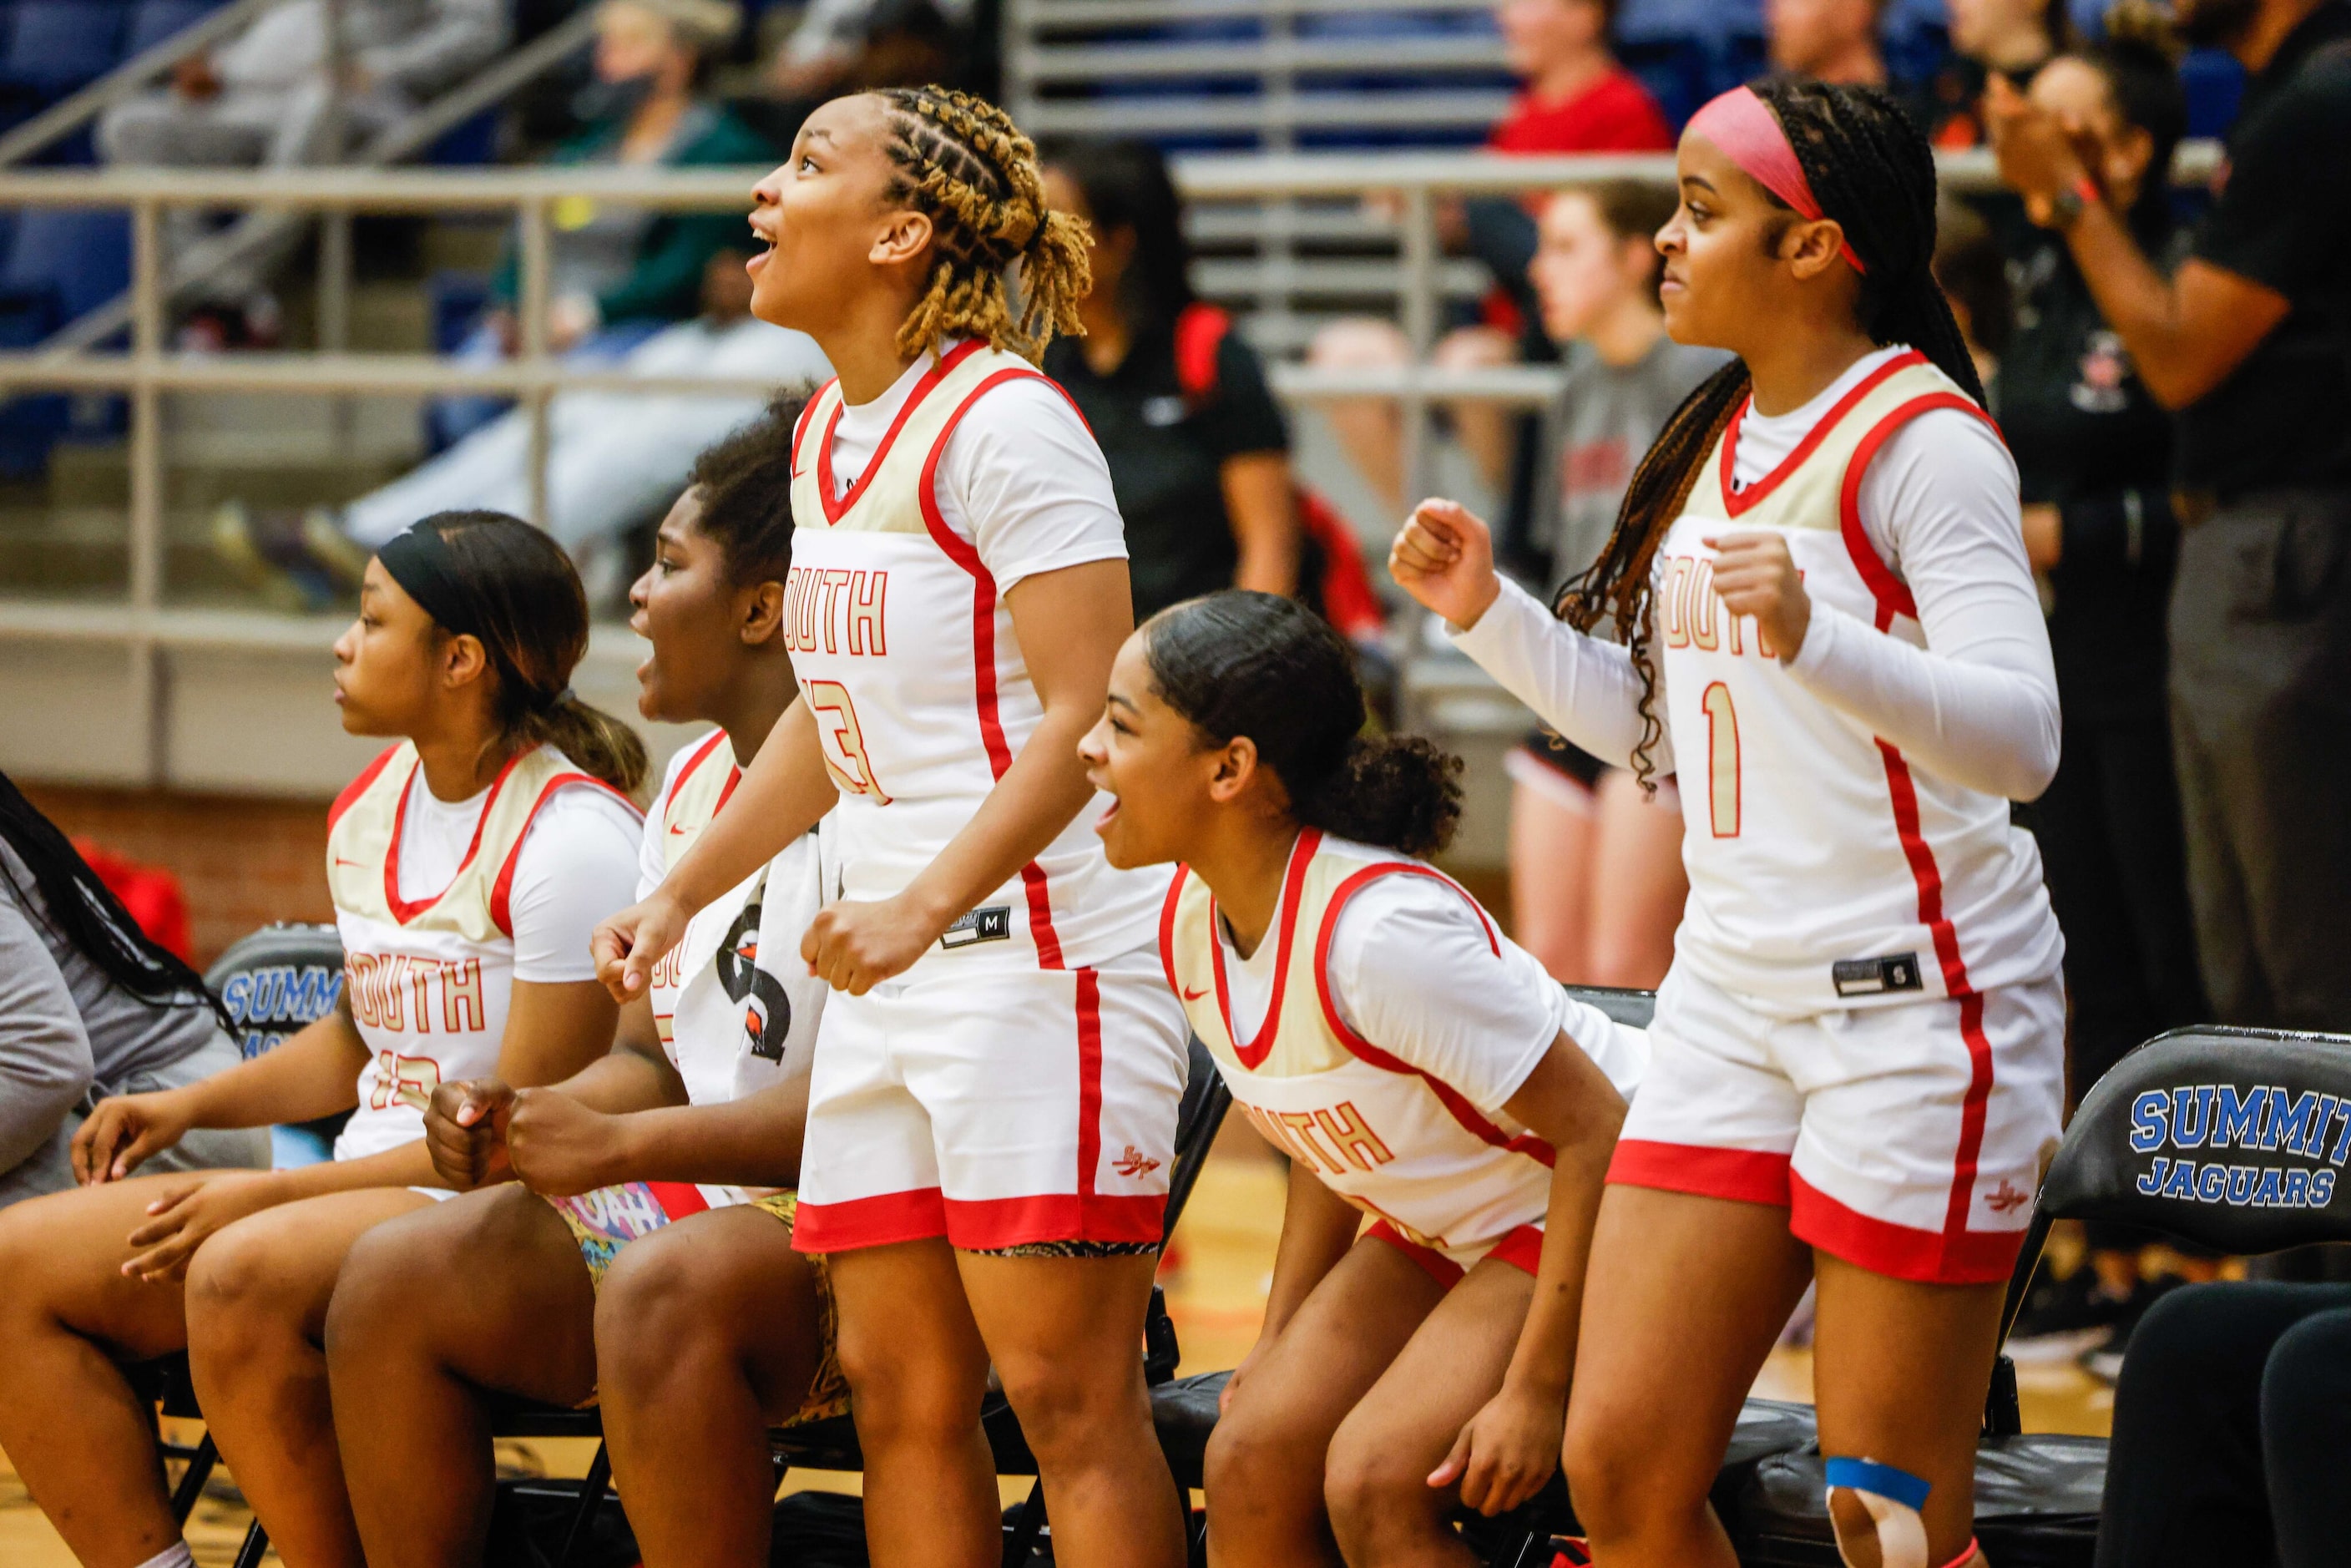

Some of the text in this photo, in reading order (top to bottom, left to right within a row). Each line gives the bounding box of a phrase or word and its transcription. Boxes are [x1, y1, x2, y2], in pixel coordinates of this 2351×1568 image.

[1702, 680, 1741, 837] 1
[985, 915, 999, 932] M
[2136, 1156, 2336, 1208] JAGUARS
